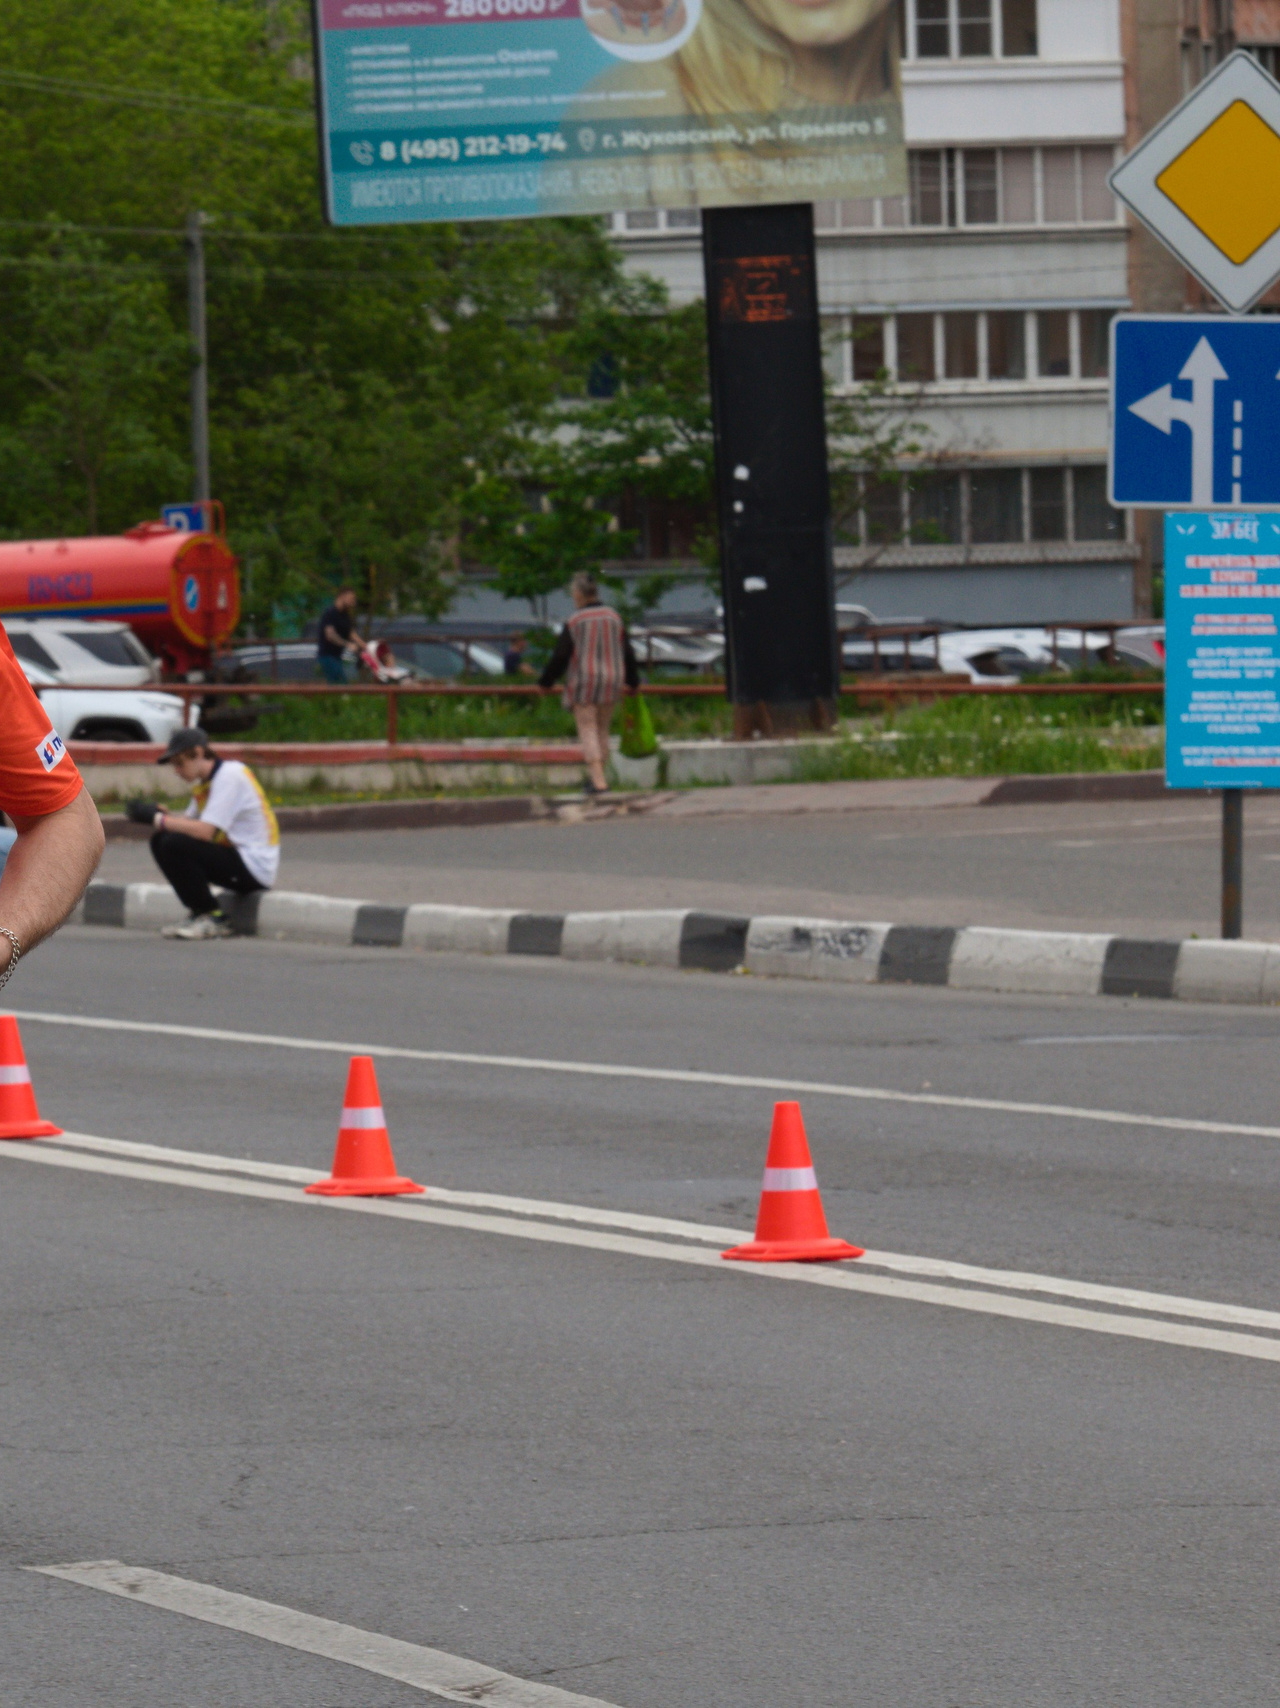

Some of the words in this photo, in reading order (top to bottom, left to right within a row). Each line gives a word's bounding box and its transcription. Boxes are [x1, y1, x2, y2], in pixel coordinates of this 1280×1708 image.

[380, 141, 396, 161] 8
[401, 137, 460, 164] (495)
[464, 132, 567, 157] 212-19-74
[622, 124, 743, 149] Жуковский,
[746, 127, 774, 144] ул.
[780, 120, 869, 141] Горького
